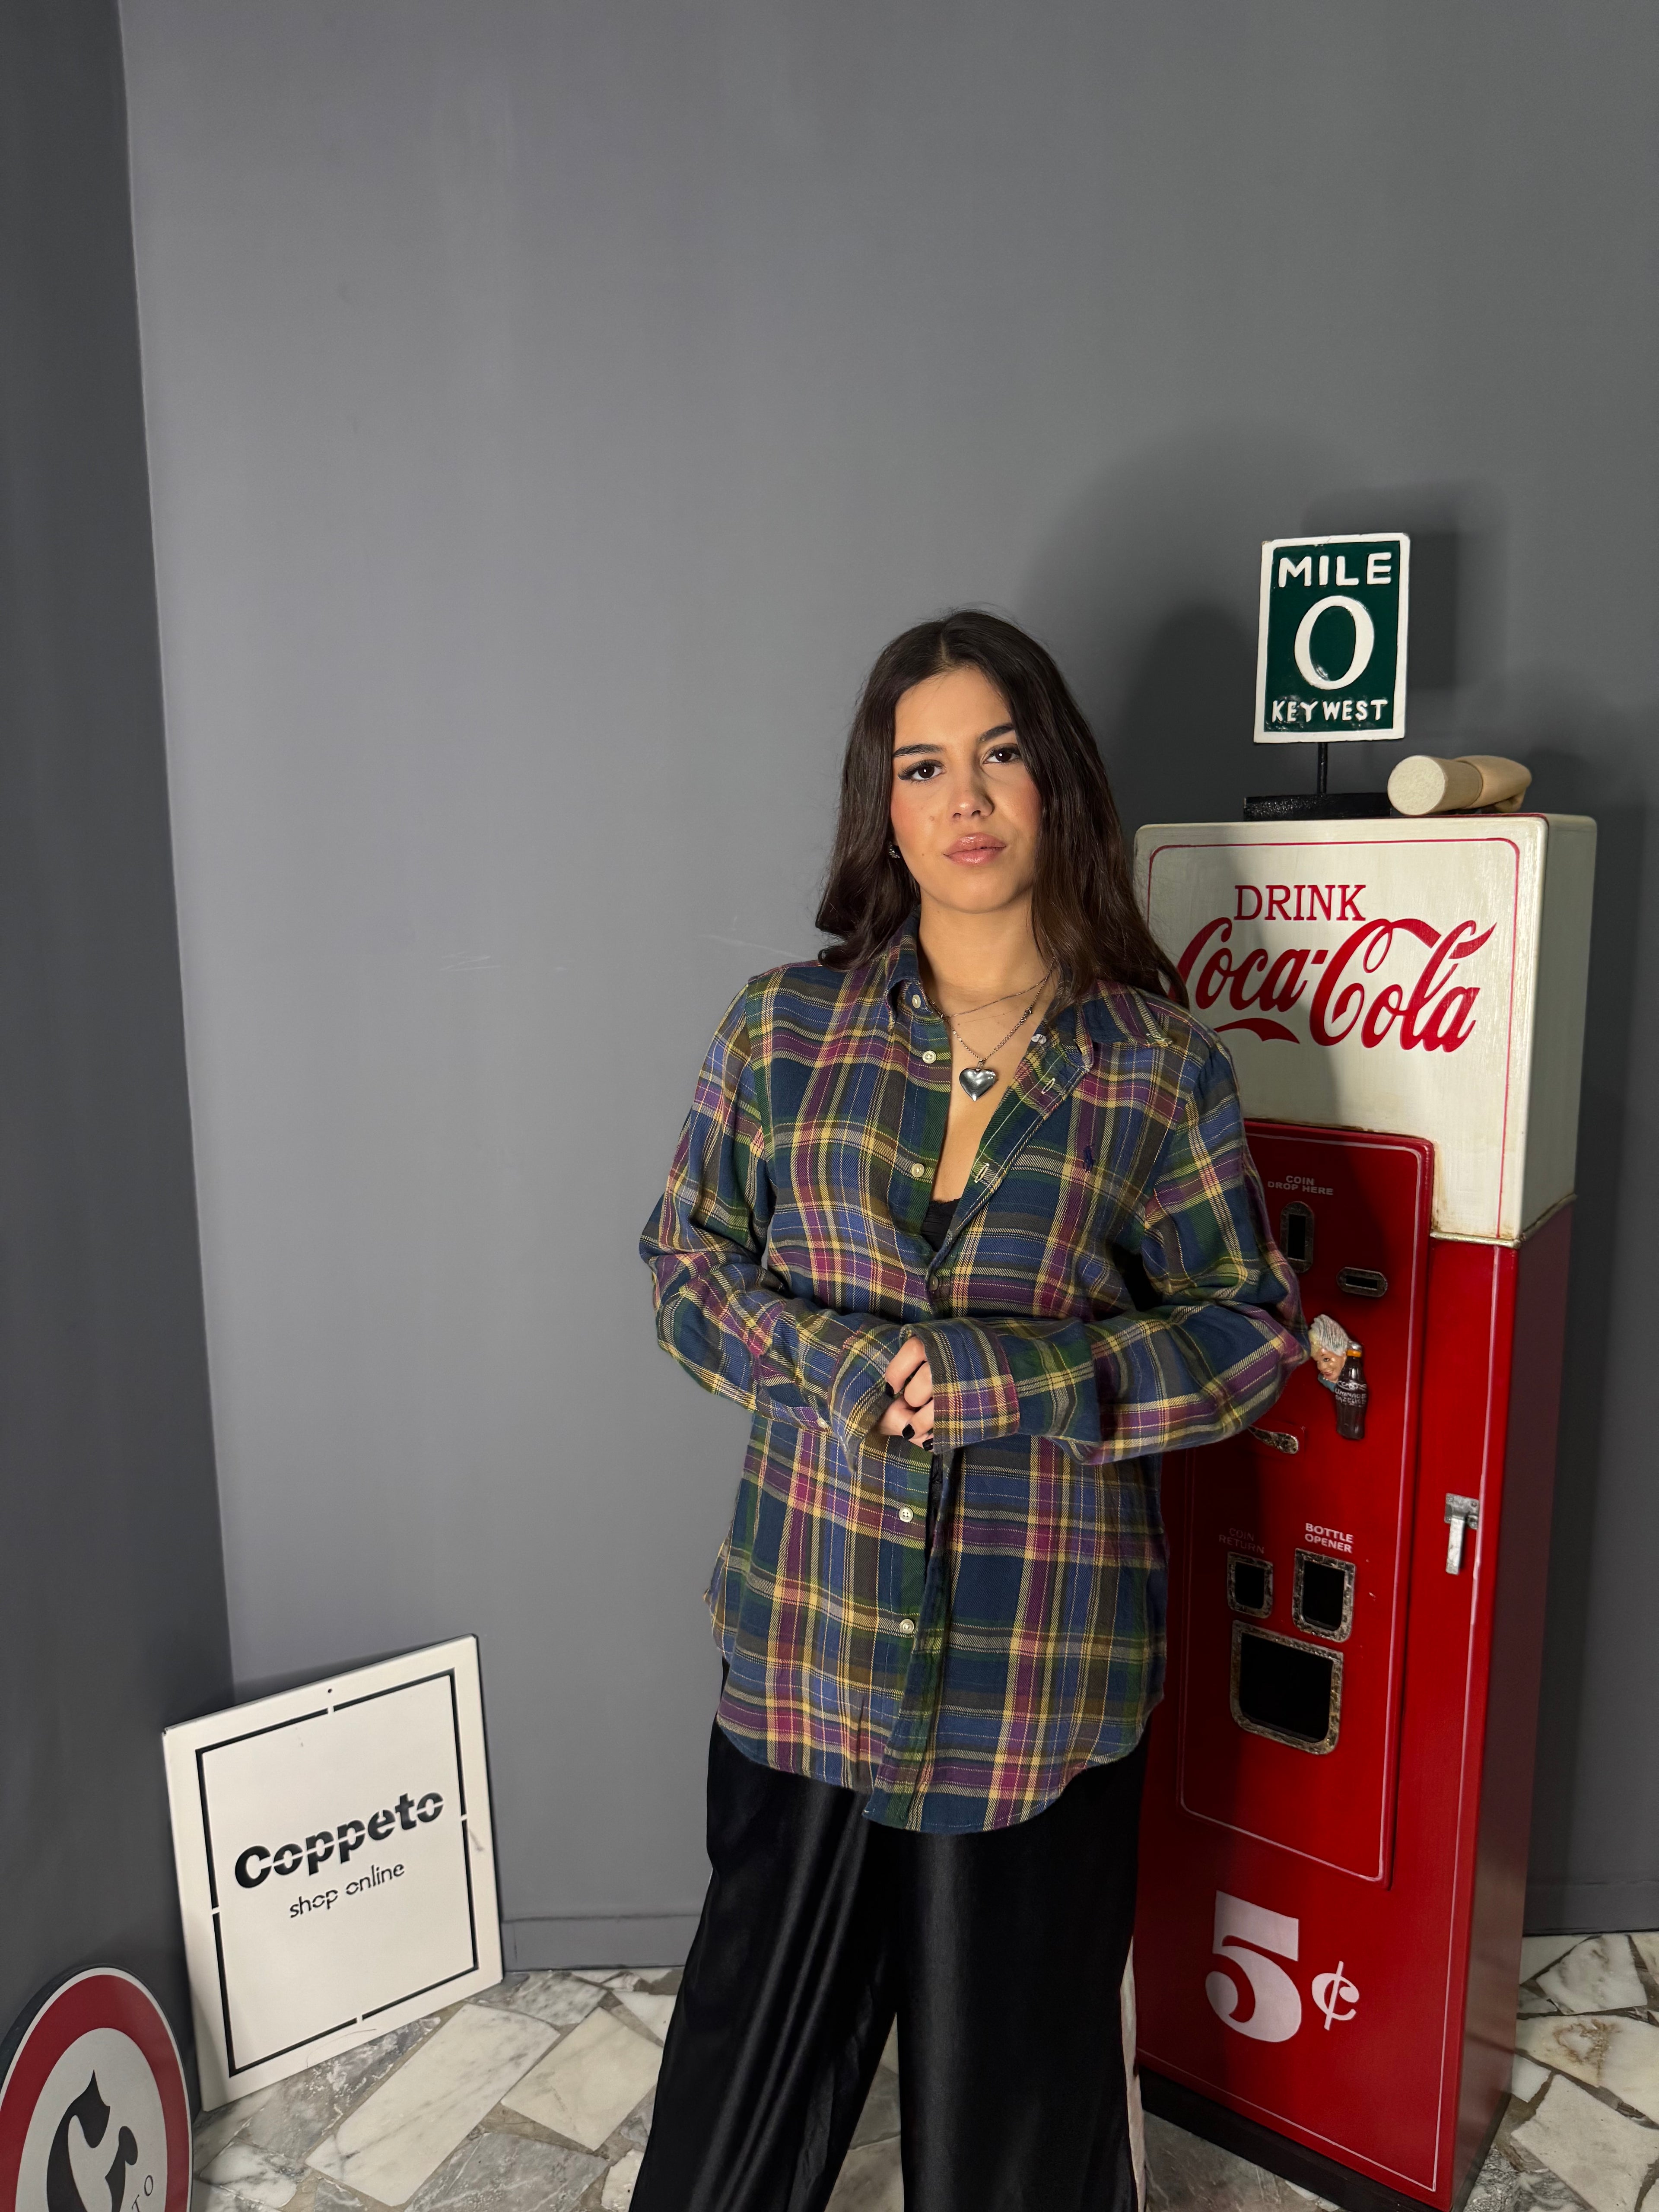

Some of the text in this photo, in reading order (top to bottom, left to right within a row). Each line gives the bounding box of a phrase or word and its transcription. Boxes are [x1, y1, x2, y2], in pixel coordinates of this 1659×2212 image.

[1278, 552, 1392, 588] MILE
[1271, 699, 1389, 723] KEY WEST
[1233, 884, 1367, 921] DRINK
[1267, 1181, 1334, 1195] DROP HERE
[1286, 1175, 1314, 1185] COIN
[1219, 1534, 1265, 1554] RETURN
[1229, 1528, 1254, 1541] COIN
[1304, 1533, 1353, 1554] OPENER
[1305, 1523, 1354, 1544] BOTTLE
[235, 1792, 444, 1888] Coppeto
[289, 1863, 405, 1918] shop online
